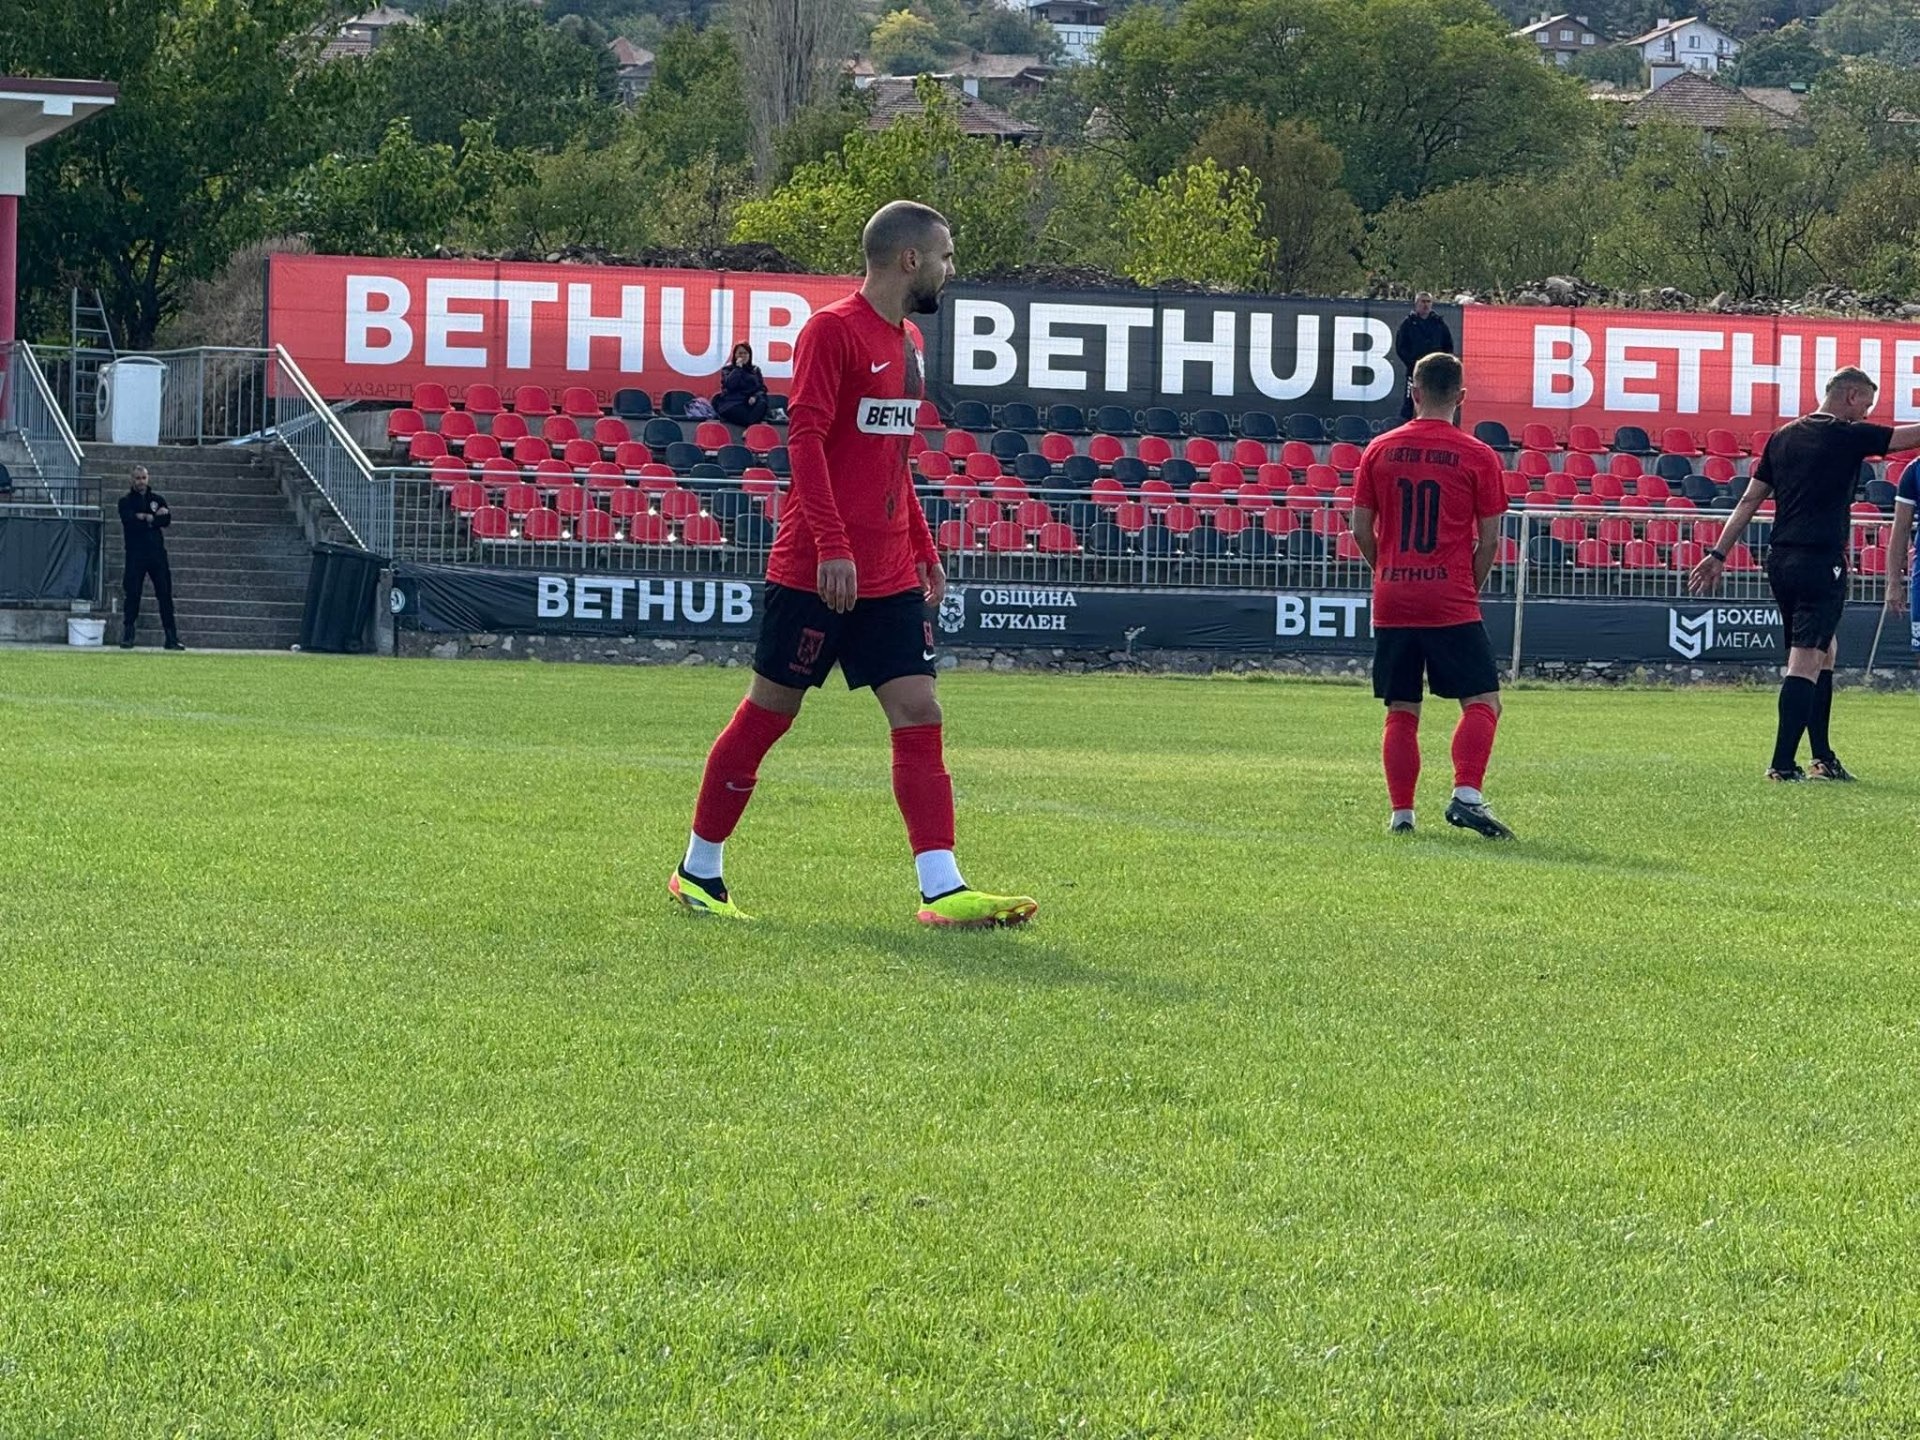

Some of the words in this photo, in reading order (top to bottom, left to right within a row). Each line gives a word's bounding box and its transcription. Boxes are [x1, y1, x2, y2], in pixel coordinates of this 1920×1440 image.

[344, 274, 812, 379] BETHUB
[952, 298, 1396, 402] BETHUB
[341, 382, 417, 398] ХАЗАРТЪ
[865, 405, 919, 428] BETHU
[1397, 477, 1441, 555] 10
[537, 576, 754, 624] BETHUB
[980, 589, 1077, 608] ОБЩИНА
[979, 612, 1067, 630] КУКЛЕН
[1276, 596, 1375, 638] BET
[1717, 608, 1783, 626] БОХЕМ
[1716, 631, 1776, 649] МЕТАЛ
